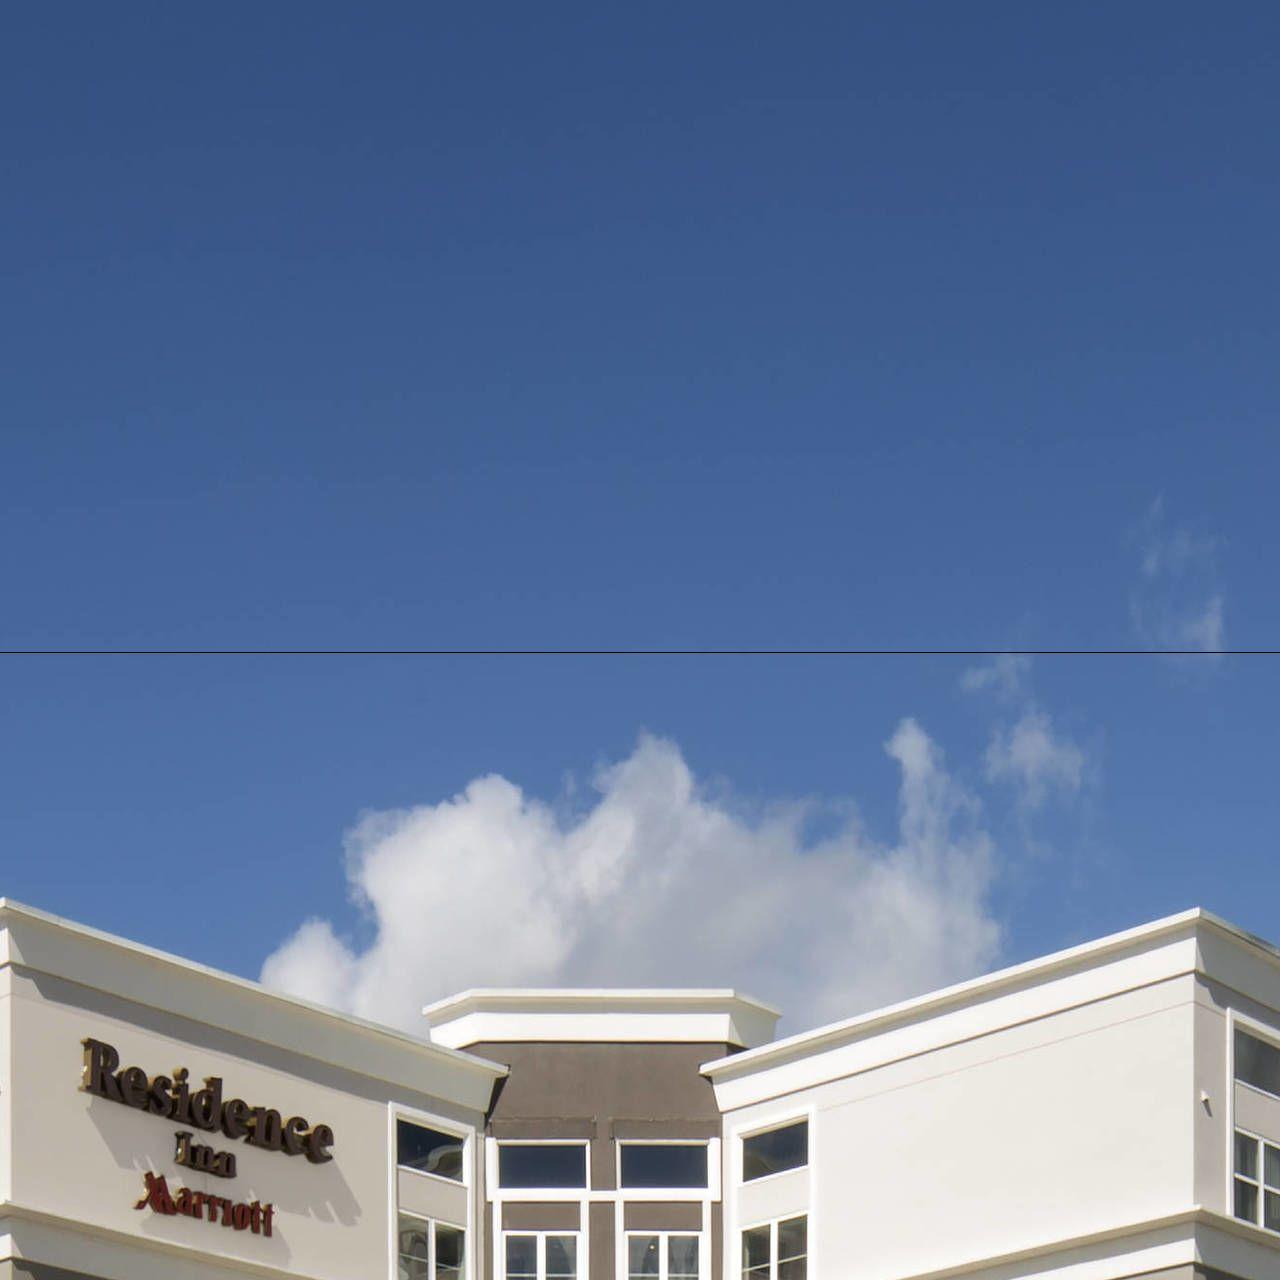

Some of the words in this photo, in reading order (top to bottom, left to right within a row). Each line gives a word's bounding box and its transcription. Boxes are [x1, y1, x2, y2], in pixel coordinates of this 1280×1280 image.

[78, 1038, 334, 1163] Residence
[174, 1131, 237, 1178] Inn
[133, 1171, 275, 1237] Marriott
